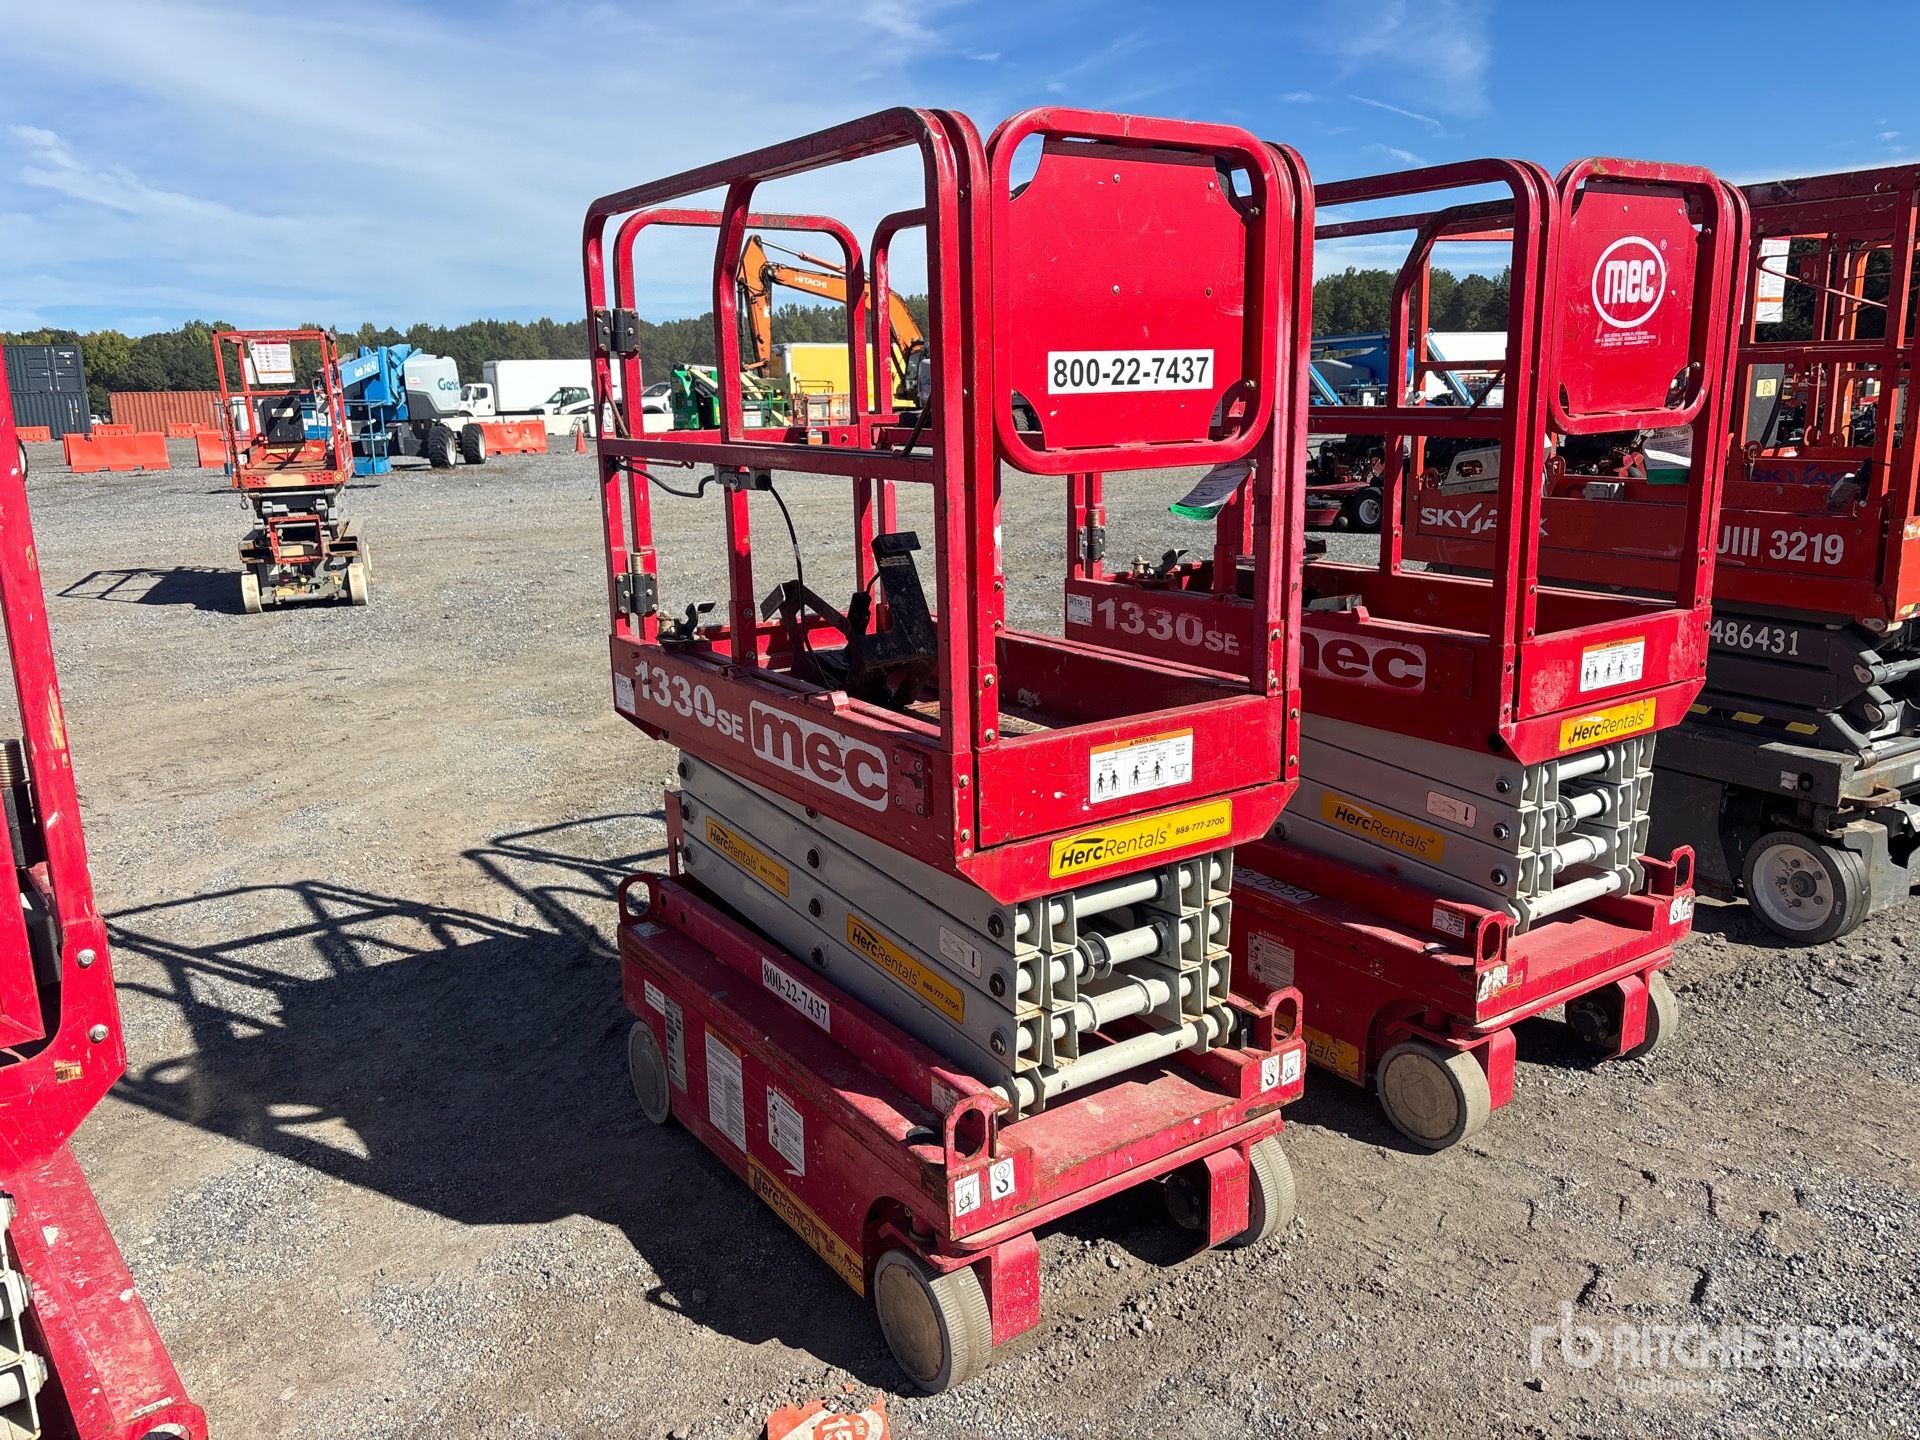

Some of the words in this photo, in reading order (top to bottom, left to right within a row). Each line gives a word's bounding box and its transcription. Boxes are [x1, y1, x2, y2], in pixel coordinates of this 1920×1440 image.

[795, 275, 827, 288] HITACHI
[1604, 259, 1656, 304] mec
[1054, 356, 1209, 388] 800-22-7437
[1650, 429, 1689, 440] ercRentals
[1769, 529, 1844, 565] 3219
[1709, 618, 1799, 656] 486431
[1135, 735, 1157, 745] WARNING
[1571, 710, 1645, 743] HercRentals
[752, 706, 888, 801] mec
[1060, 827, 1168, 870] HercRentals
[1175, 816, 1225, 835] 888-777-2700
[1334, 805, 1428, 852] HercRentals
[710, 827, 758, 871] HercRentals
[760, 865, 786, 887] 888-777-2700
[1263, 930, 1284, 943] DANGER
[852, 927, 918, 986] HercRentals
[922, 980, 960, 1012] 888-777-2700
[764, 963, 827, 1025] 800-22-7437
[854, 1420, 866, 1436] BAY
